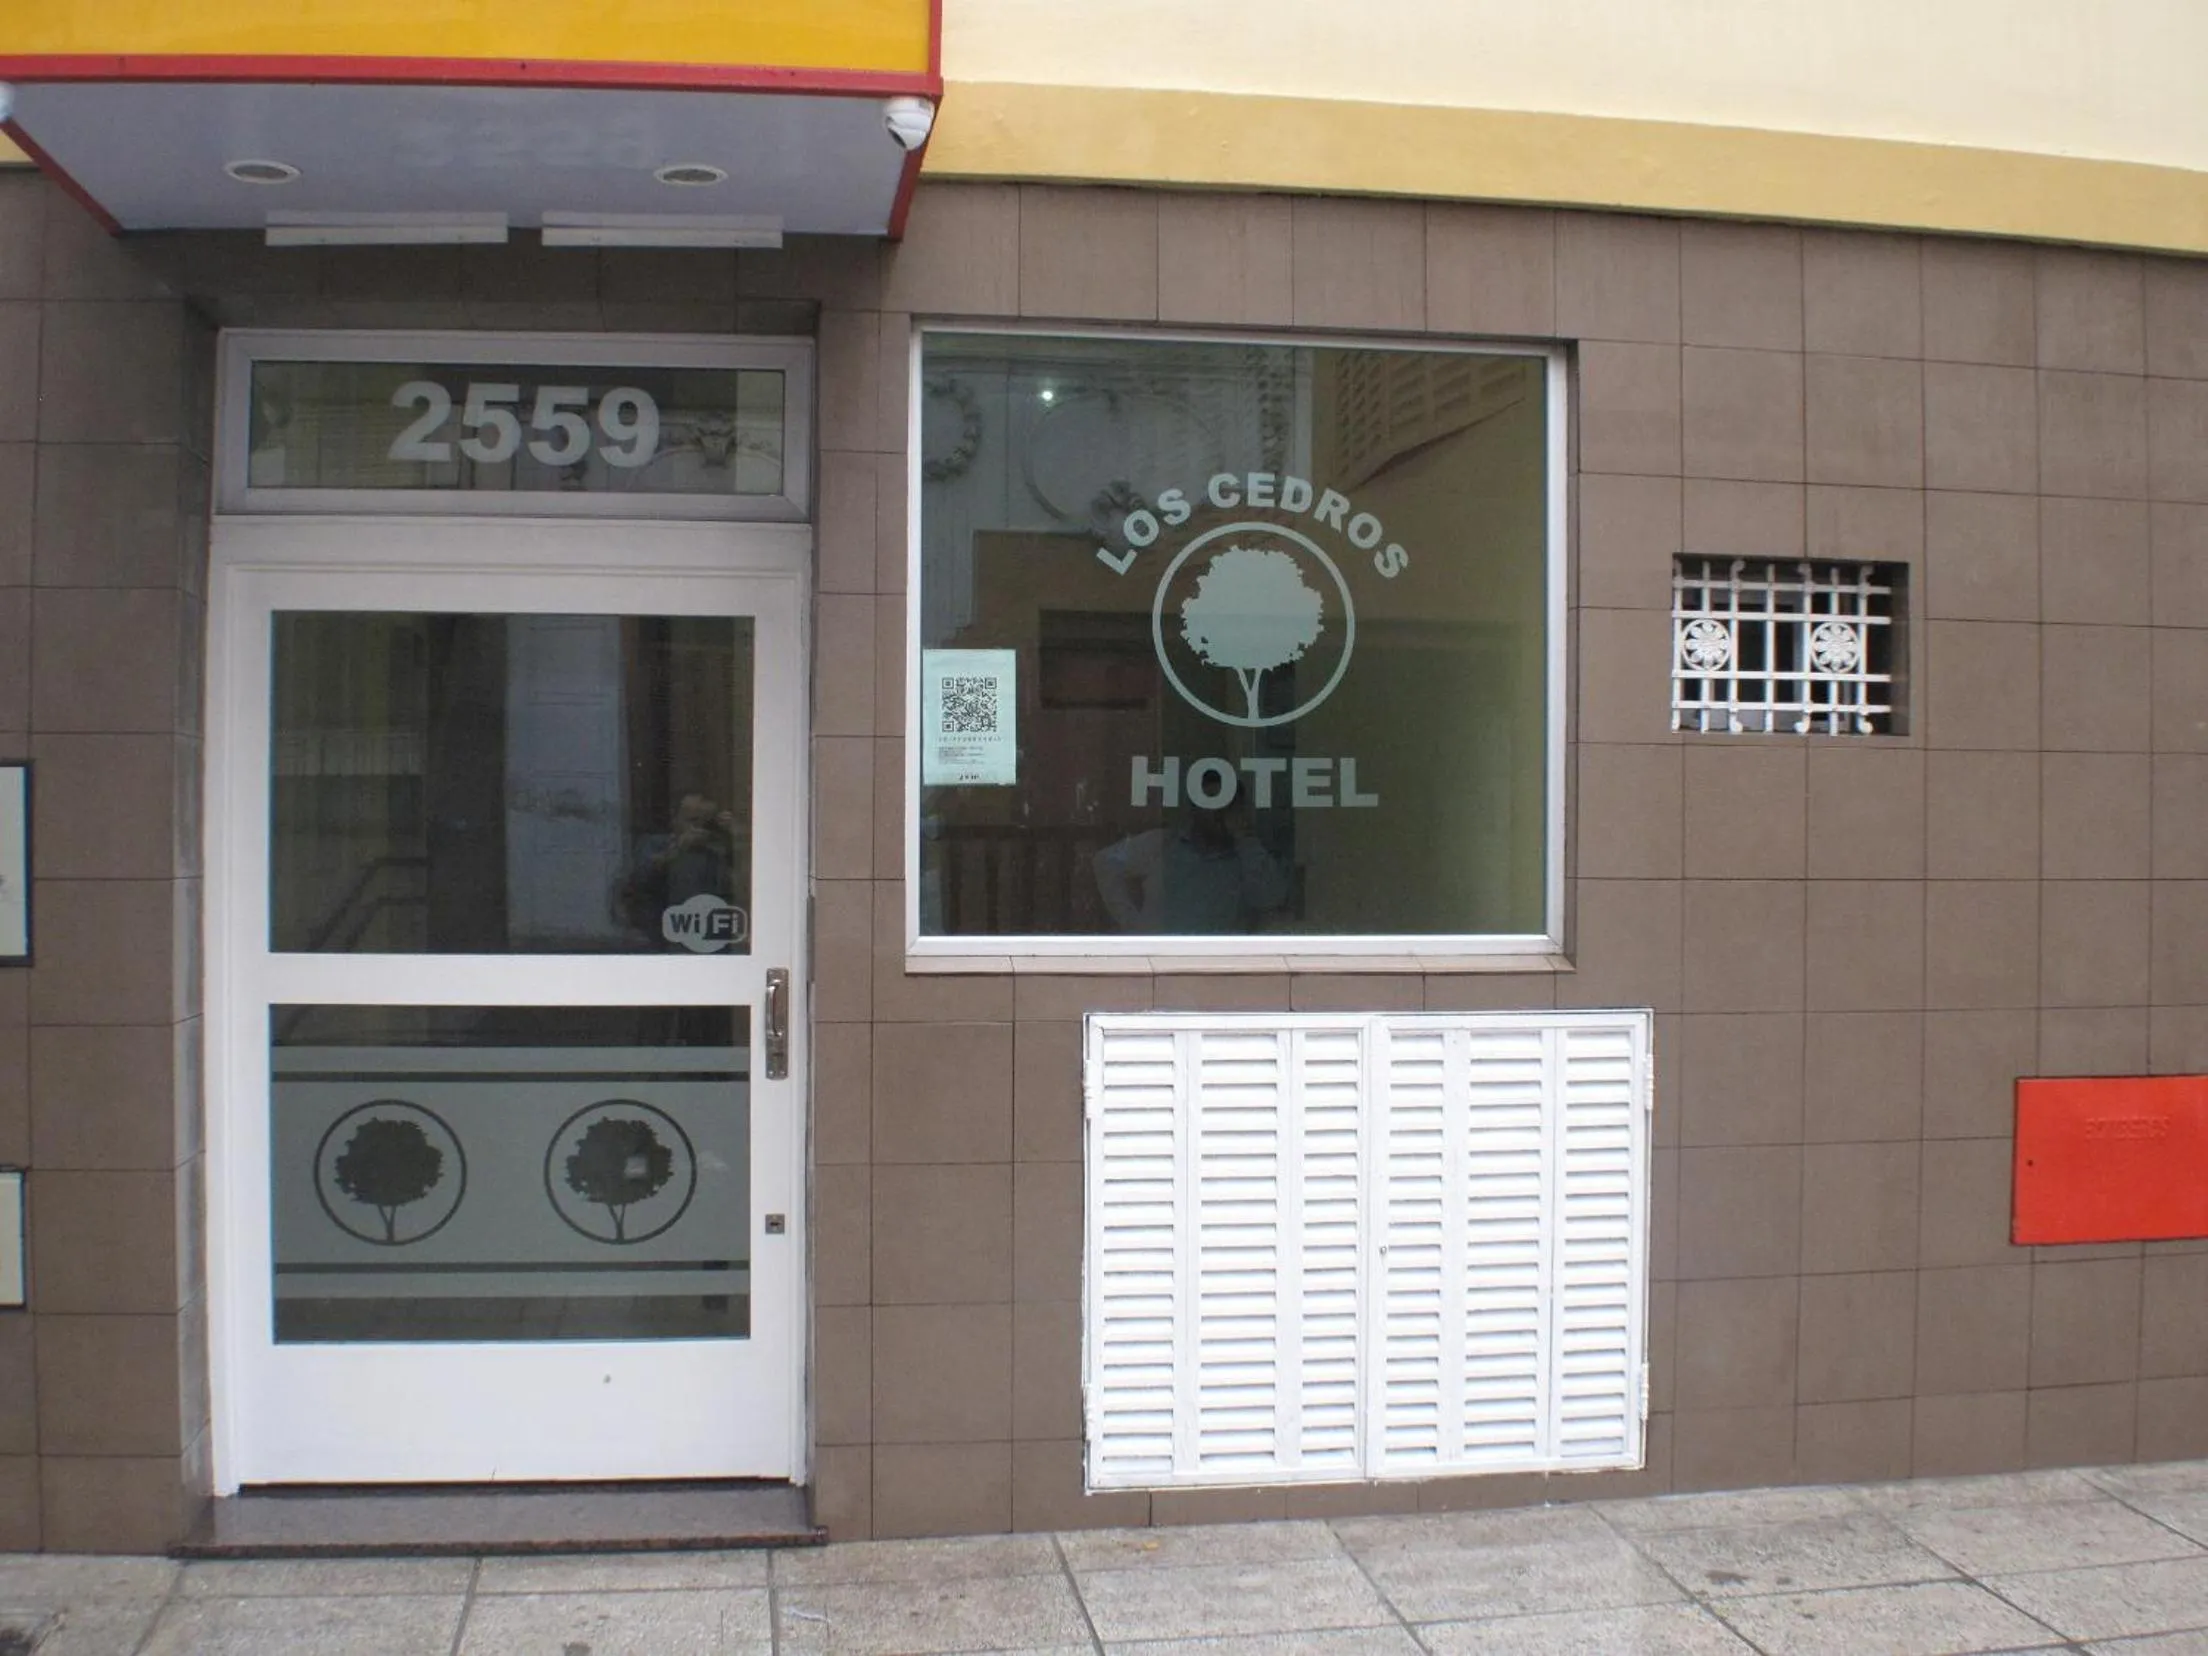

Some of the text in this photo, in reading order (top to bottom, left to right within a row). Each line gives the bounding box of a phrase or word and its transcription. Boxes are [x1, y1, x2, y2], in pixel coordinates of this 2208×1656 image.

[387, 380, 660, 468] 2559
[1096, 471, 1409, 579] LOS CEDROS
[1130, 755, 1379, 810] HOTEL
